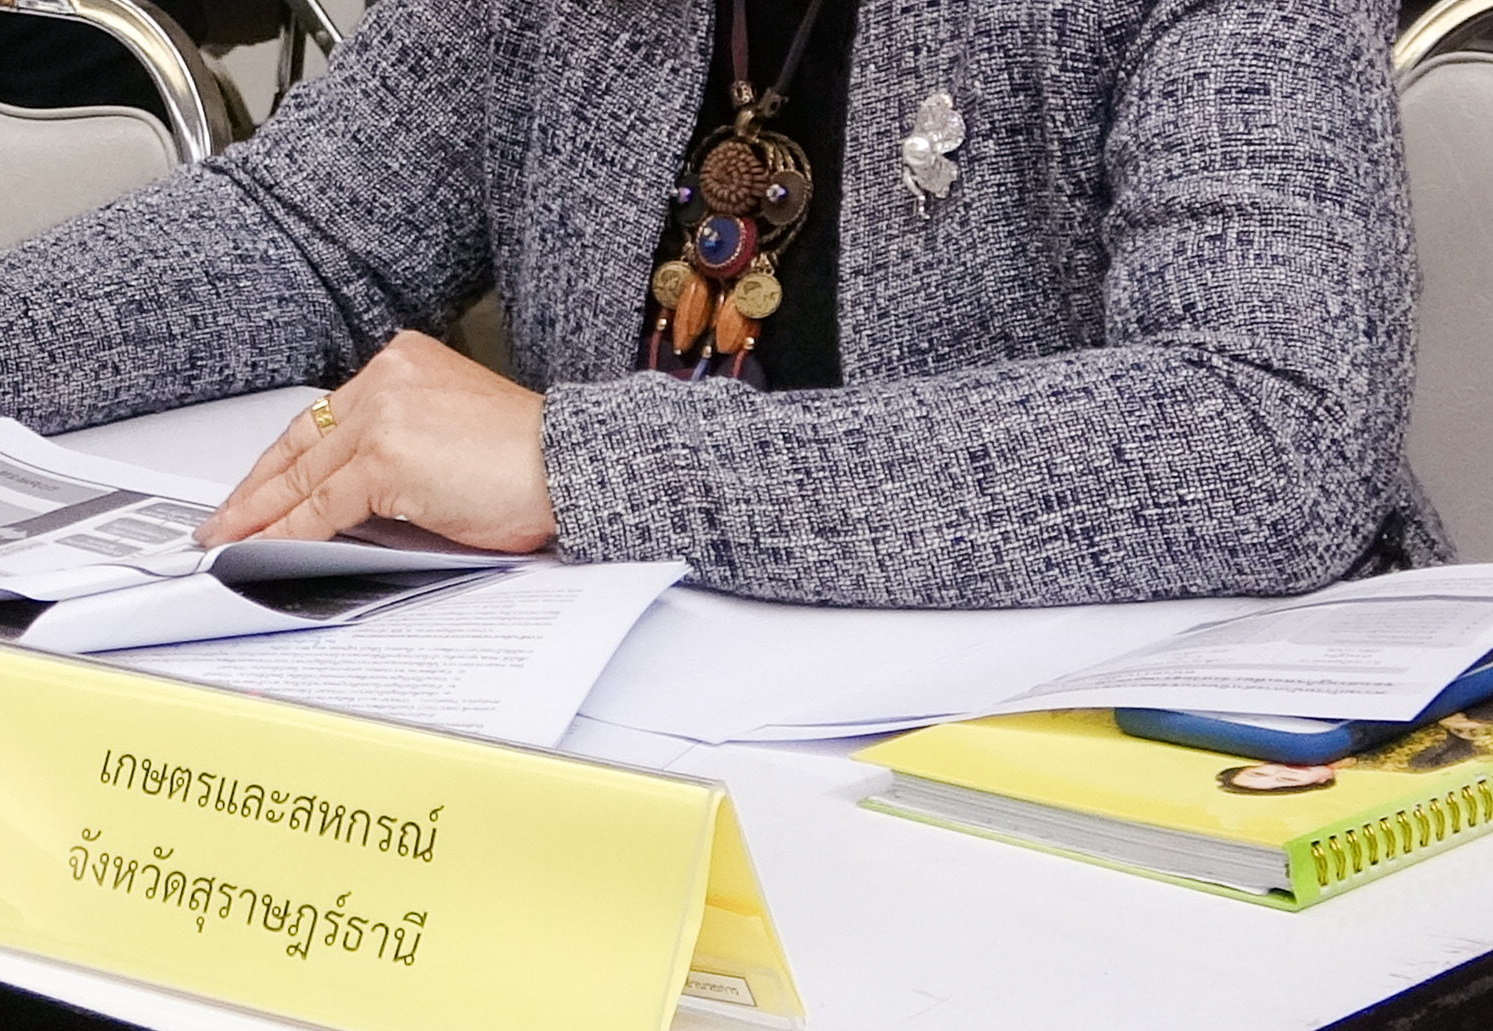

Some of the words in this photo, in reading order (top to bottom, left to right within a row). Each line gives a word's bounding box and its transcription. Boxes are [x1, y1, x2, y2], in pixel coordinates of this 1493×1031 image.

[99, 748, 445, 863] เกษตรและสหกรณ์
[68, 827, 428, 966] จังหวัดสุราษฎร์ธานี
